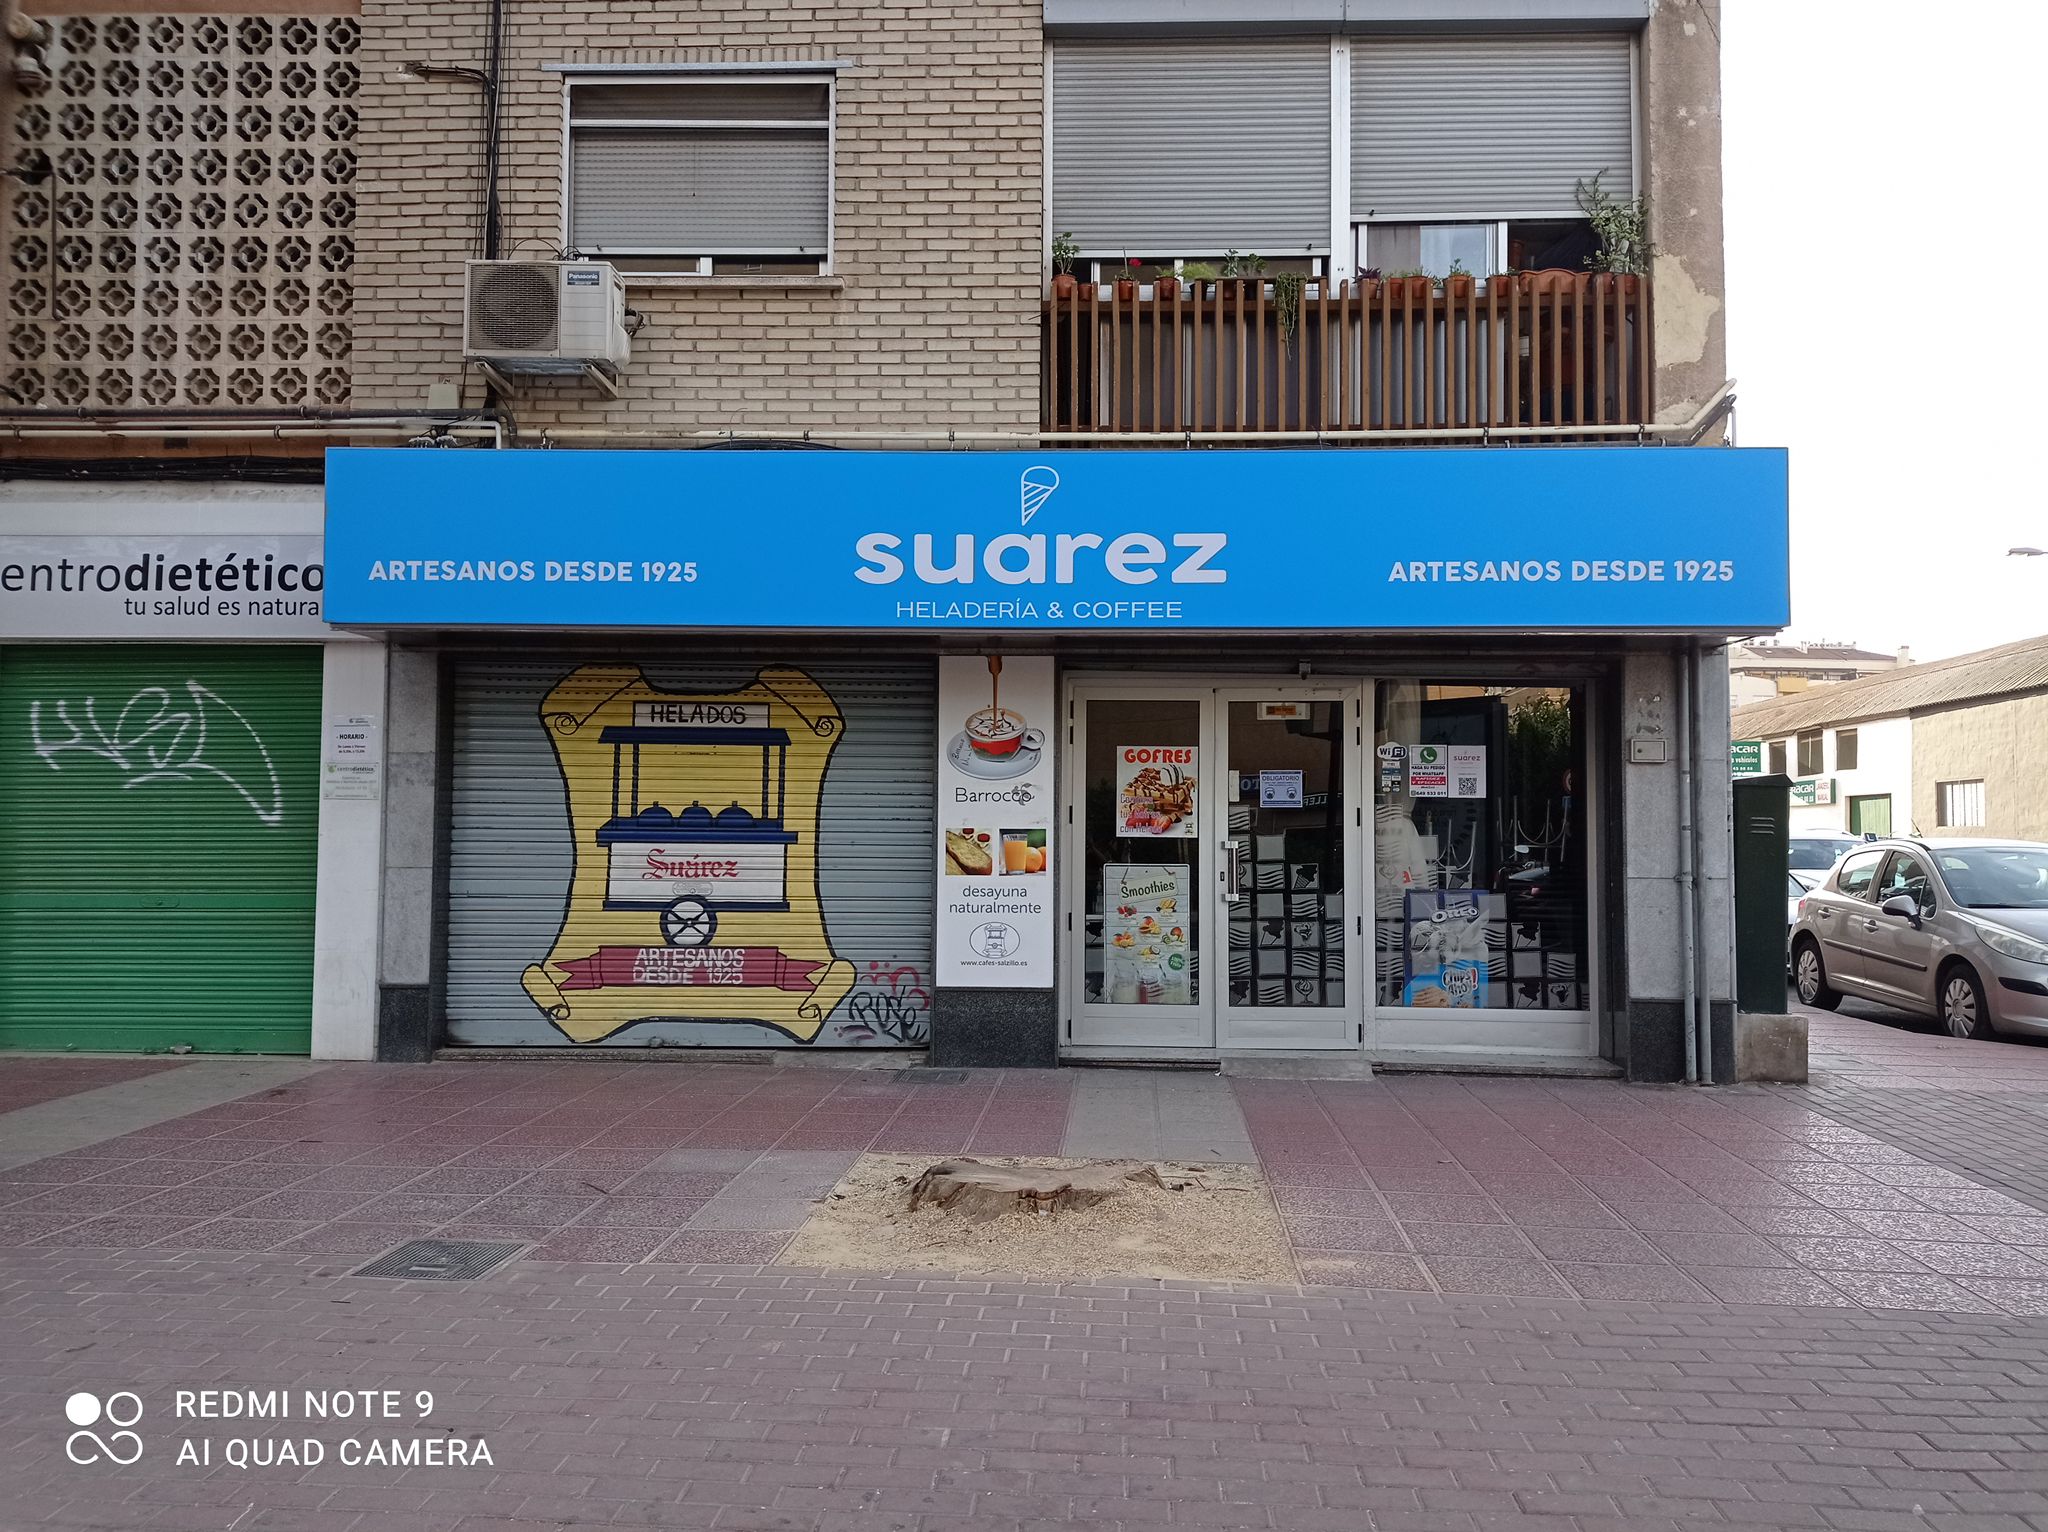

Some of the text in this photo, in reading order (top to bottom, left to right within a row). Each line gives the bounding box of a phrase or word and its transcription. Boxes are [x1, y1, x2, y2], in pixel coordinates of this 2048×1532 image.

[0, 552, 324, 592] entrodietético
[368, 560, 698, 583] ARTESANOS DESDE 1925
[1388, 560, 1734, 582] ARTESANOS DESDE 1925
[124, 595, 319, 616] tu salud es natura
[896, 597, 1183, 619] HELADERÍA & COFFEE
[650, 704, 747, 725] HELADOS
[1124, 748, 1192, 764] GOFRES
[955, 787, 1032, 803] Barrocco
[642, 848, 739, 880] Suárez
[962, 885, 1027, 900] desayuna
[1121, 881, 1176, 899] Smoothies
[949, 901, 1042, 914] naturalmente
[1431, 907, 1479, 923] OREO
[634, 948, 746, 967] ARTESANOS
[960, 959, 1028, 967] www.cafes-salzillo.es
[632, 967, 744, 984] DESDE 1925
